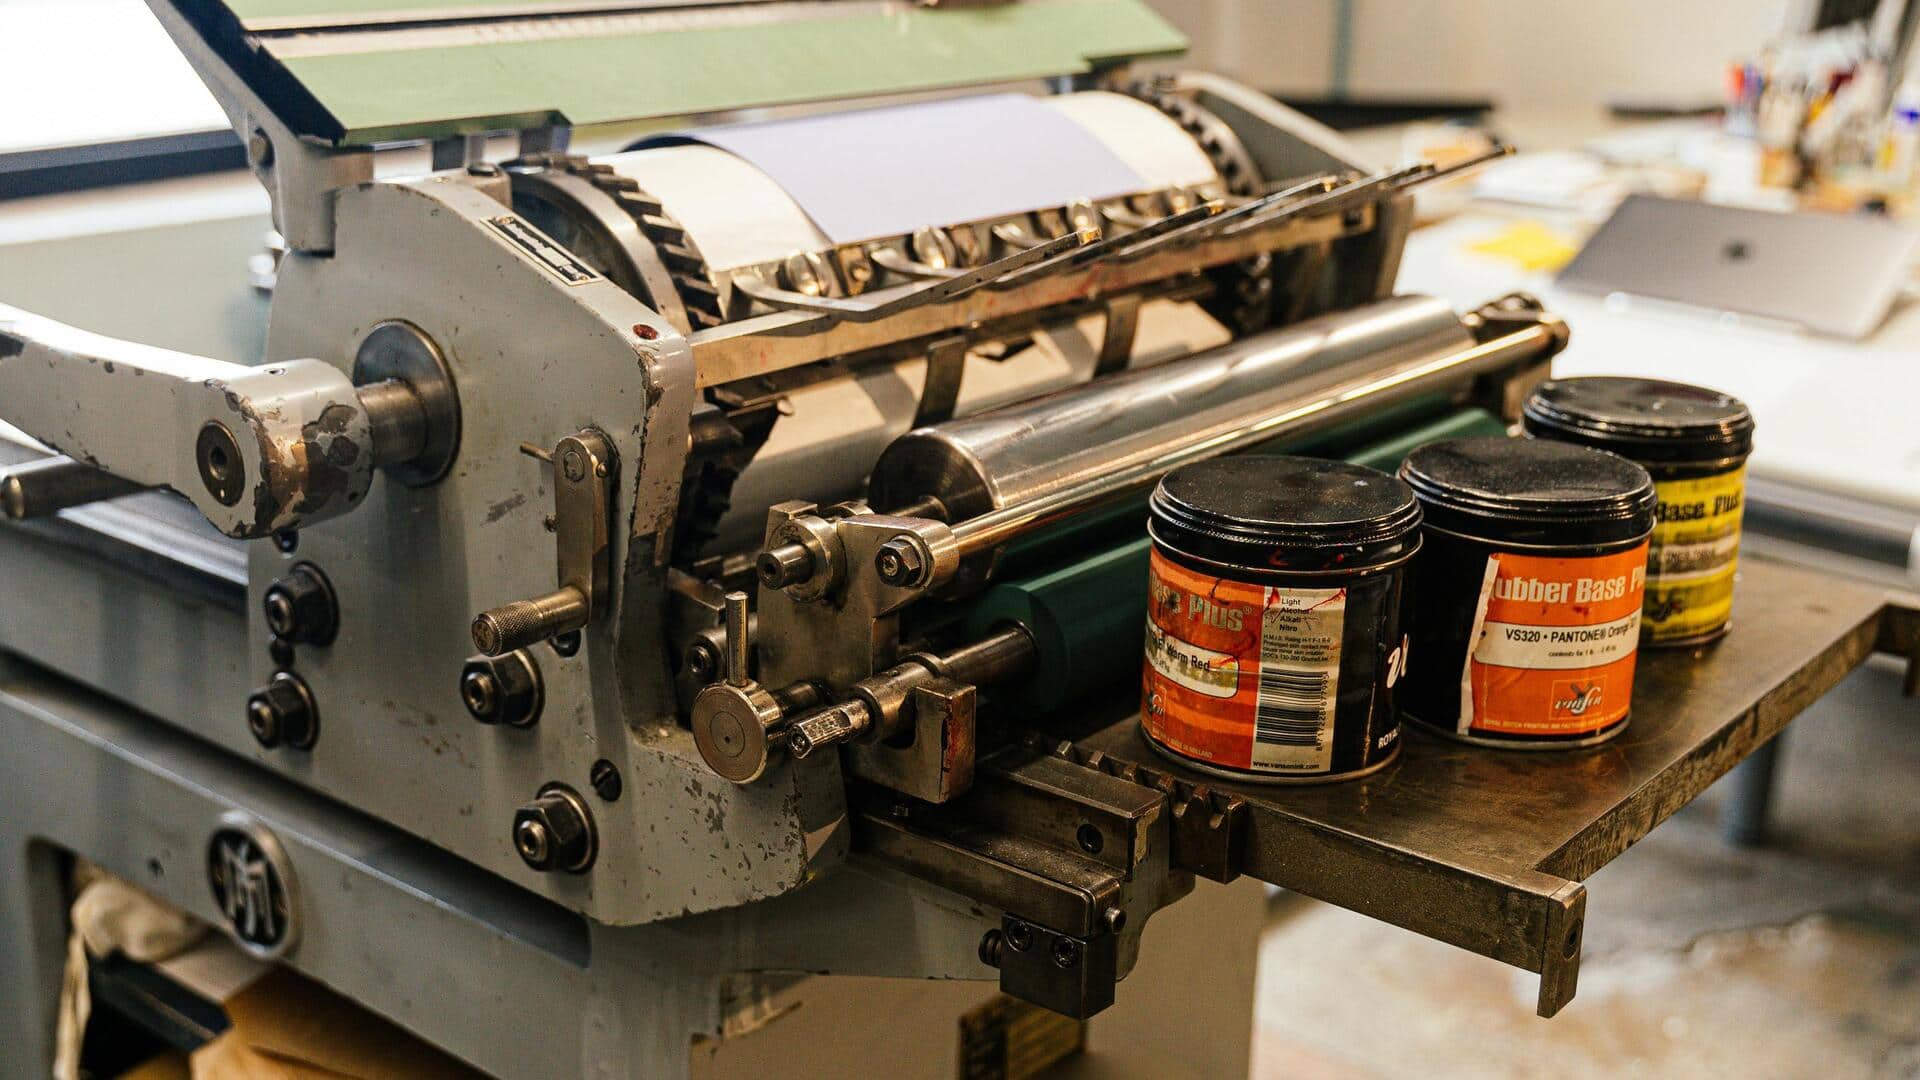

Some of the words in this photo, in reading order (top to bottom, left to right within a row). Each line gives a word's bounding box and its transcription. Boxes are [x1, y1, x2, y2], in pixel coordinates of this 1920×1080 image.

[1490, 576, 1572, 604] ubber
[1575, 575, 1626, 604] Base
[1281, 598, 1301, 606] Light
[1280, 607, 1310, 615] Alcohol
[1279, 624, 1298, 632] Nitro
[1505, 628, 1541, 643] VS320
[1166, 643, 1188, 665] Warm
[1190, 654, 1211, 672] Red
